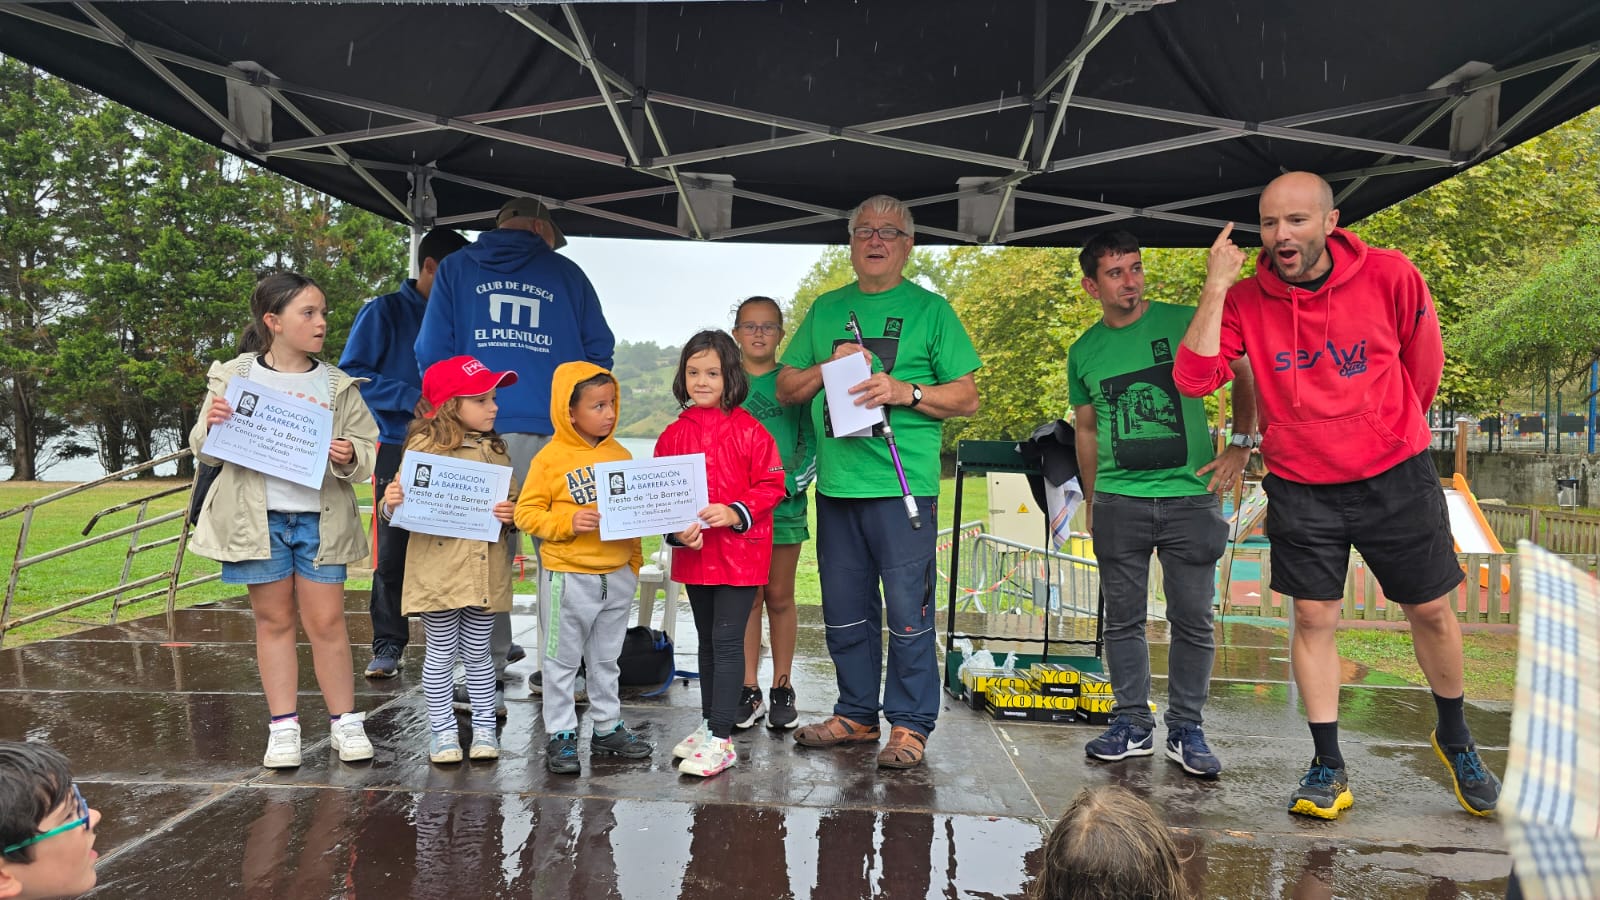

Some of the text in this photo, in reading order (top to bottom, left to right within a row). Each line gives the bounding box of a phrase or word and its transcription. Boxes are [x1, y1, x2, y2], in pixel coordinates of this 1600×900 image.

[476, 281, 554, 302] CLUB DE PESCA
[475, 329, 552, 345] EL PUENTUCU
[255, 410, 264, 419] LA
[266, 415, 300, 430] BARRERA
[256, 423, 267, 432] de
[235, 426, 264, 440] Concurso
[276, 441, 293, 450] pesca
[258, 443, 290, 457] clasificado
[632, 470, 680, 481] ASOCIACIÓN
[442, 481, 472, 491] BARRERA
[638, 481, 669, 489] BARRERA
[409, 488, 432, 497] Fiesta
[416, 499, 443, 508] Concurso
[608, 496, 632, 504] Fiesta
[996, 694, 1076, 710] YOKO
